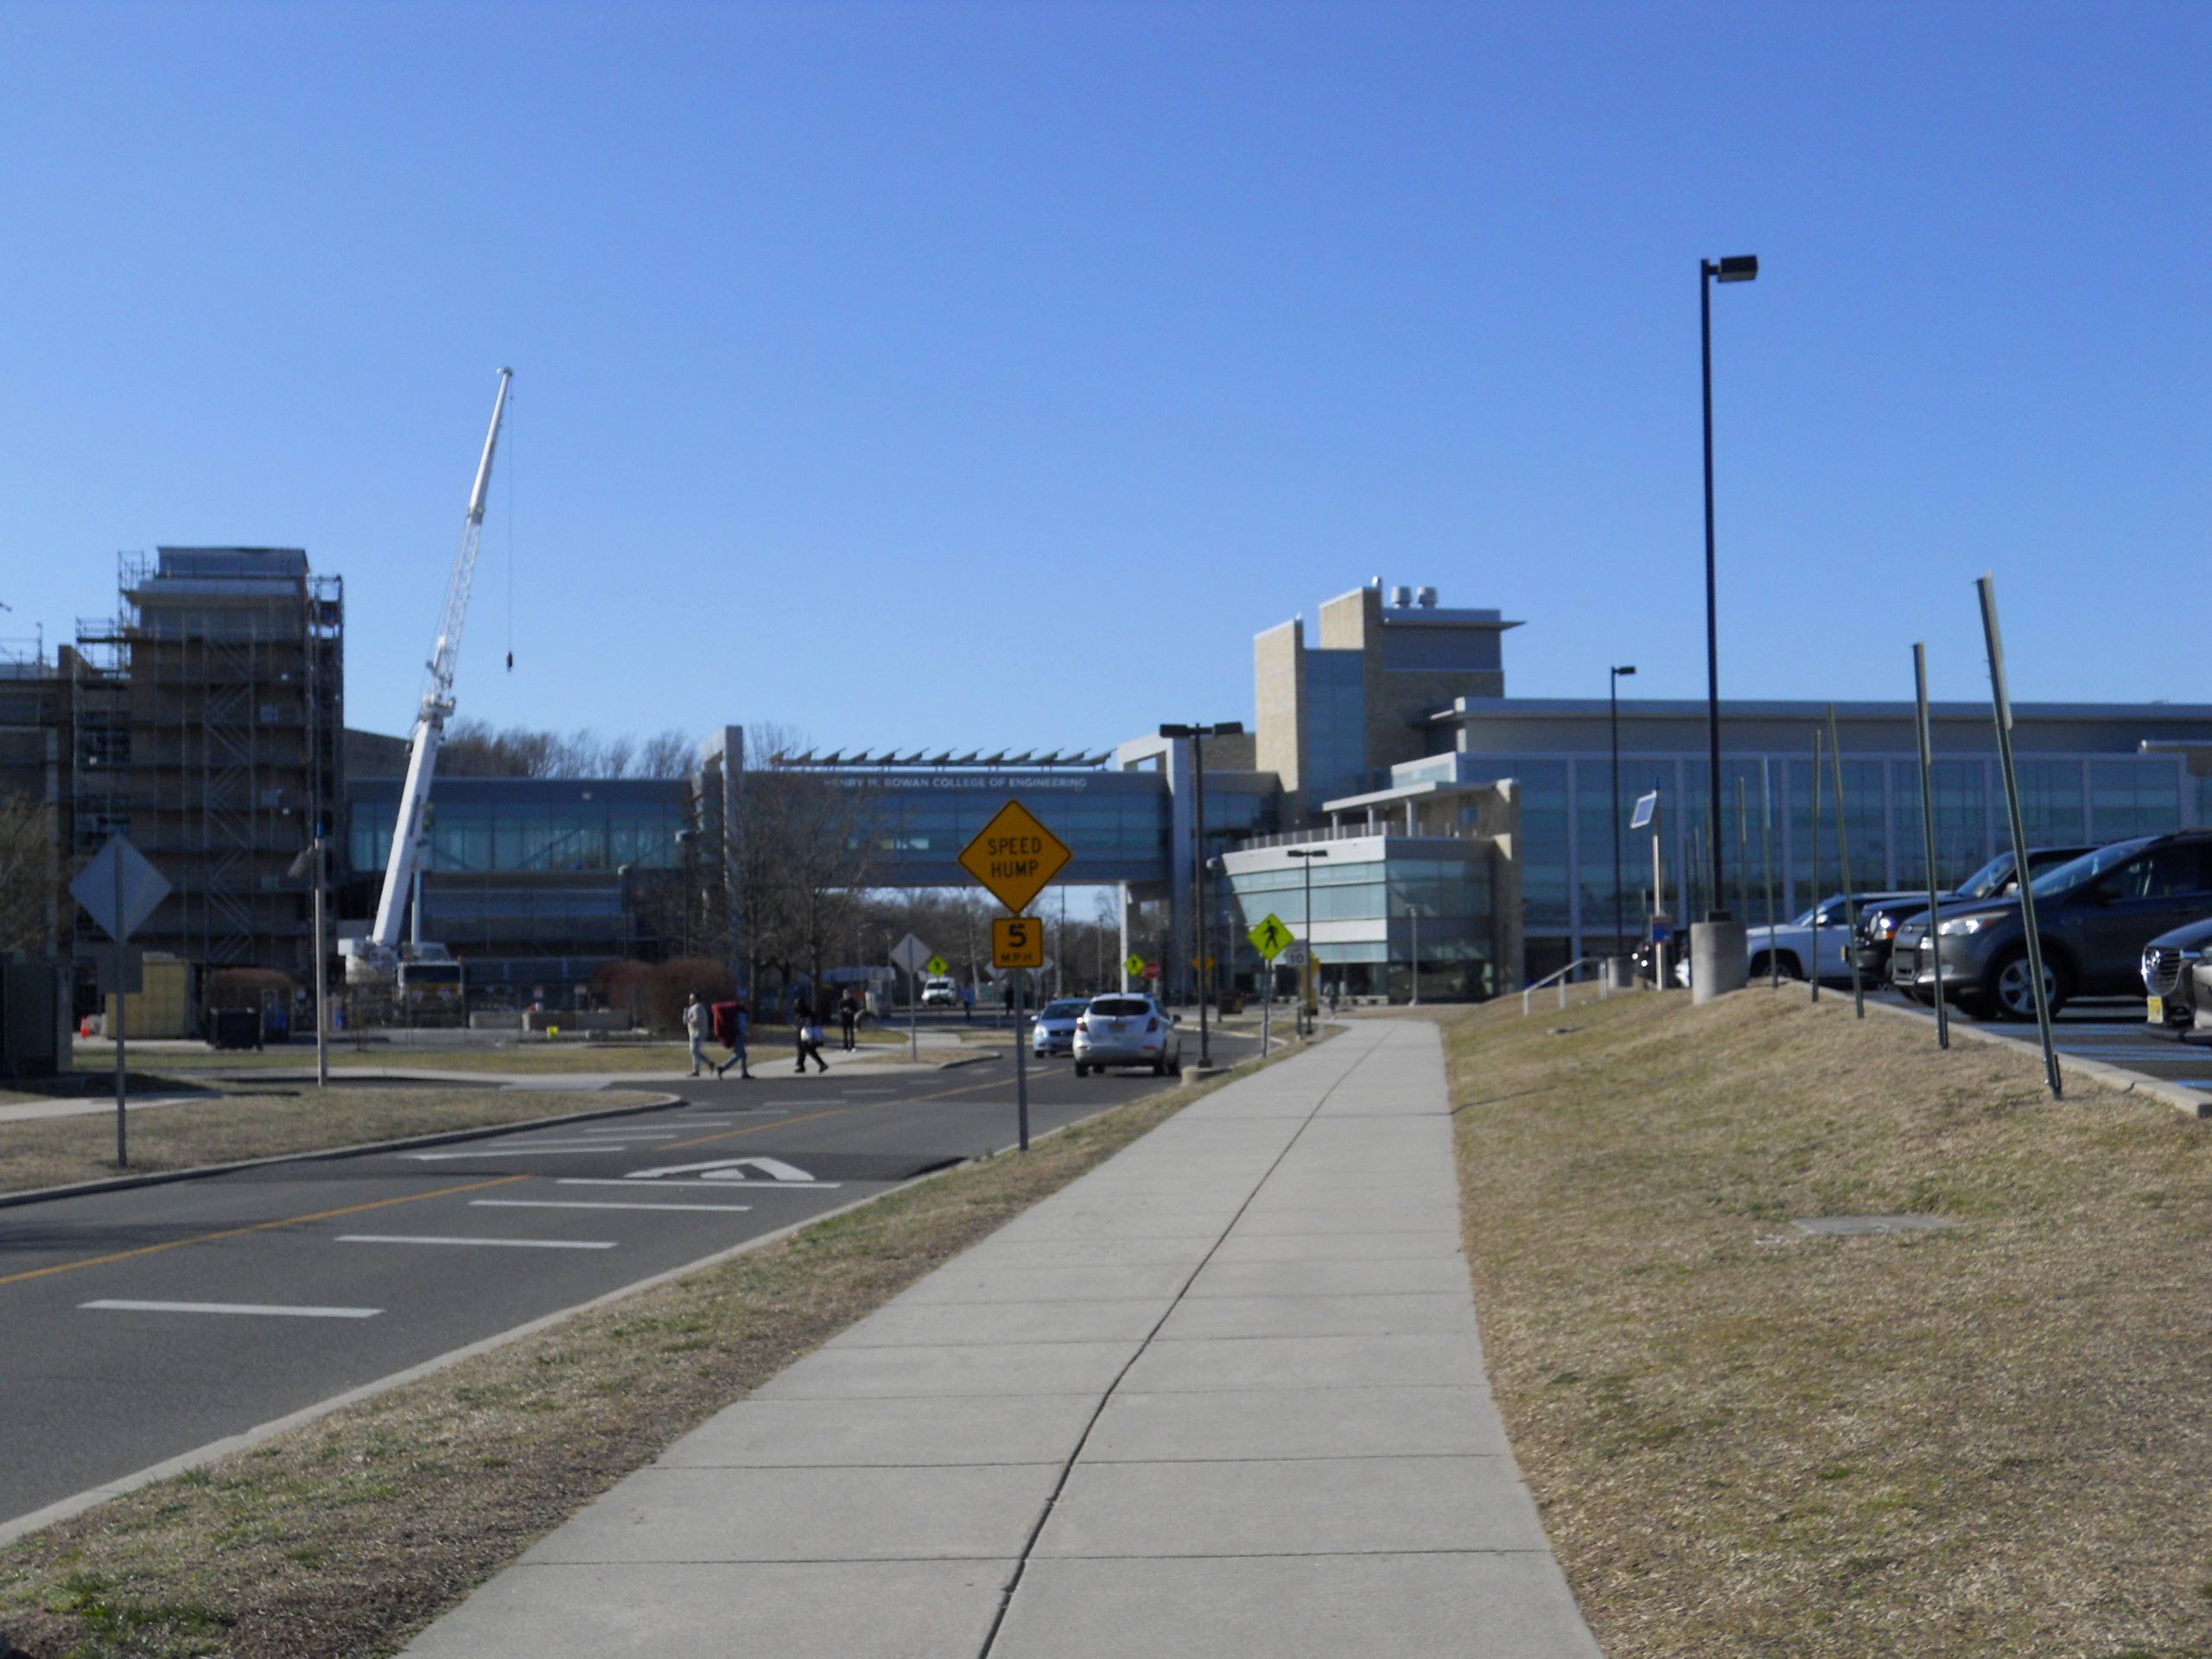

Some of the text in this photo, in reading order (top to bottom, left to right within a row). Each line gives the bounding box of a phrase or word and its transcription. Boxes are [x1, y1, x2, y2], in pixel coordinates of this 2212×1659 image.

[884, 777, 929, 788] ROWAN
[932, 777, 986, 788] COLLEGE
[989, 777, 1007, 788] OF
[1009, 777, 1087, 788] ENGINEERING
[988, 836, 1042, 855] SPEED
[990, 860, 1039, 878] HUMP
[1008, 924, 1027, 948] 5
[1290, 953, 1305, 964] 10
